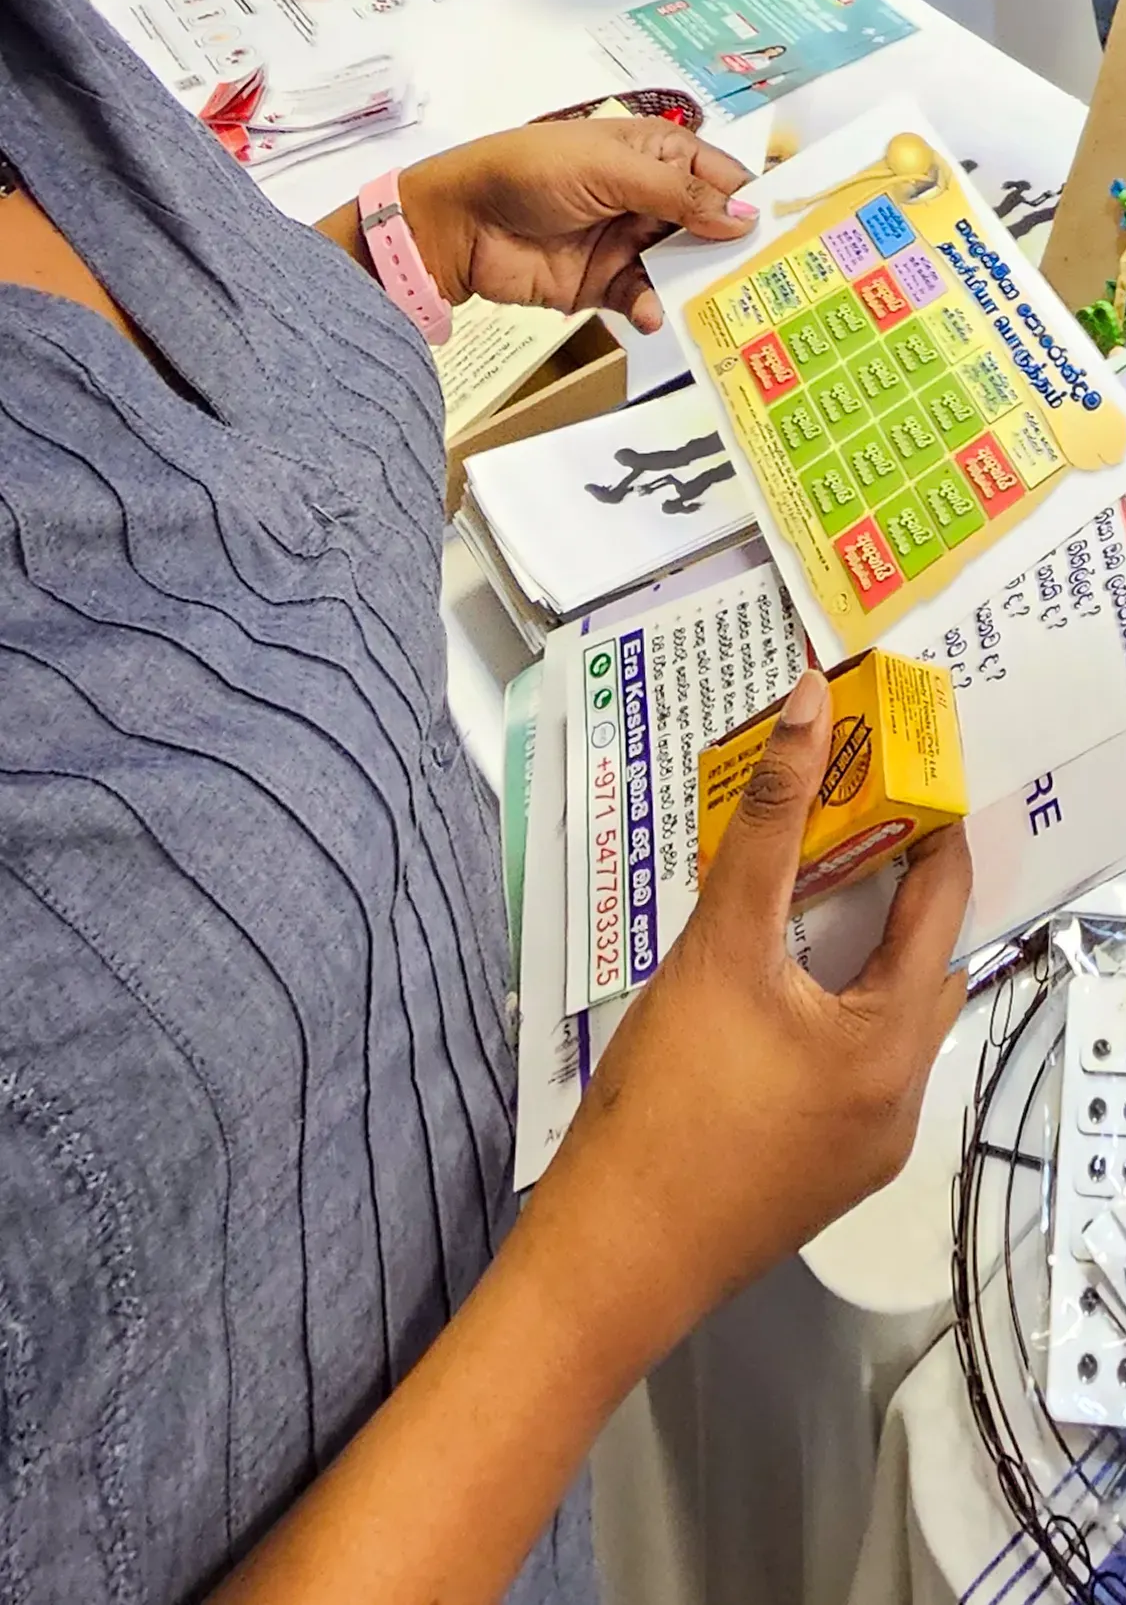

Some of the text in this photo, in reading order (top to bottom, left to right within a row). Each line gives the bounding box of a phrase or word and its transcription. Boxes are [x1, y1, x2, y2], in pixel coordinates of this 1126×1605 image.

[621, 636, 642, 682] Era
[624, 682, 645, 758] Kesha
[595, 757, 620, 986] +971 547793325
[631, 869, 652, 908] ඔබ
[631, 914, 654, 971] අතට
